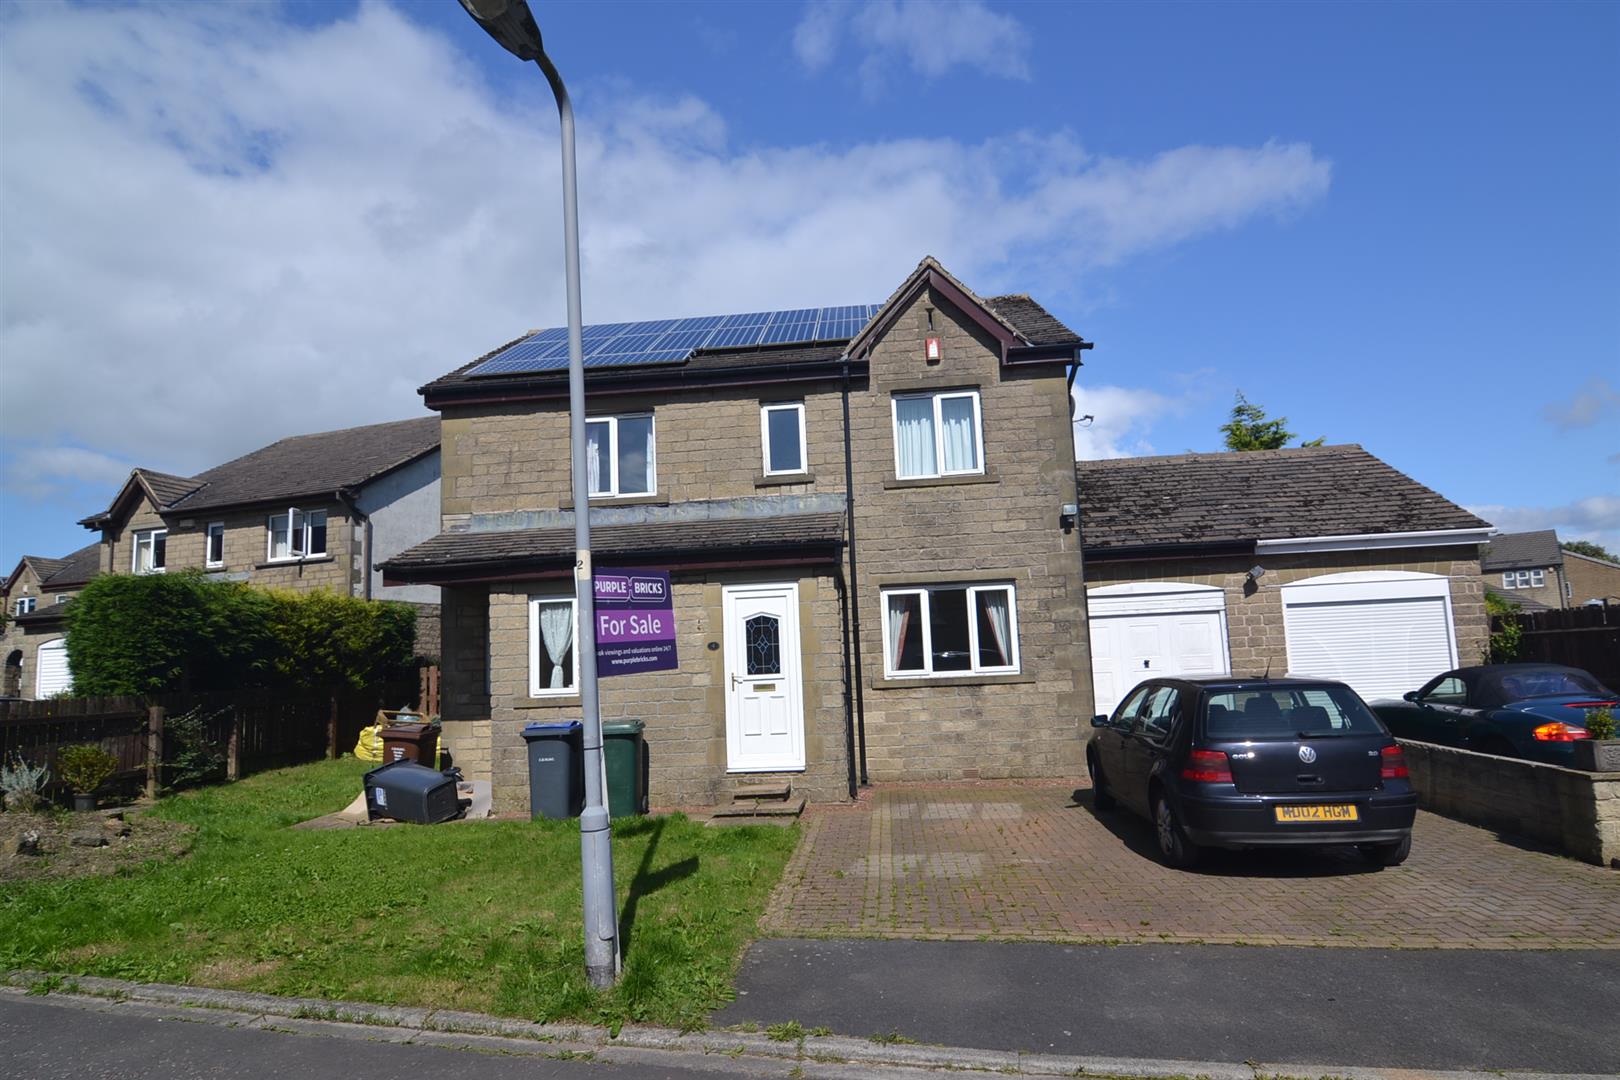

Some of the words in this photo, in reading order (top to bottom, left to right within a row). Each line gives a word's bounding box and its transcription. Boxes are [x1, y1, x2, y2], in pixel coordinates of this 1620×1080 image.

[594, 581, 627, 592] PURPLE
[634, 582, 663, 594] BRICKS
[600, 616, 626, 636] For
[630, 614, 660, 634] Sale
[612, 656, 658, 664] www.purplebricks.com
[1282, 806, 1320, 818] MD02
[1324, 805, 1351, 818] HGM
